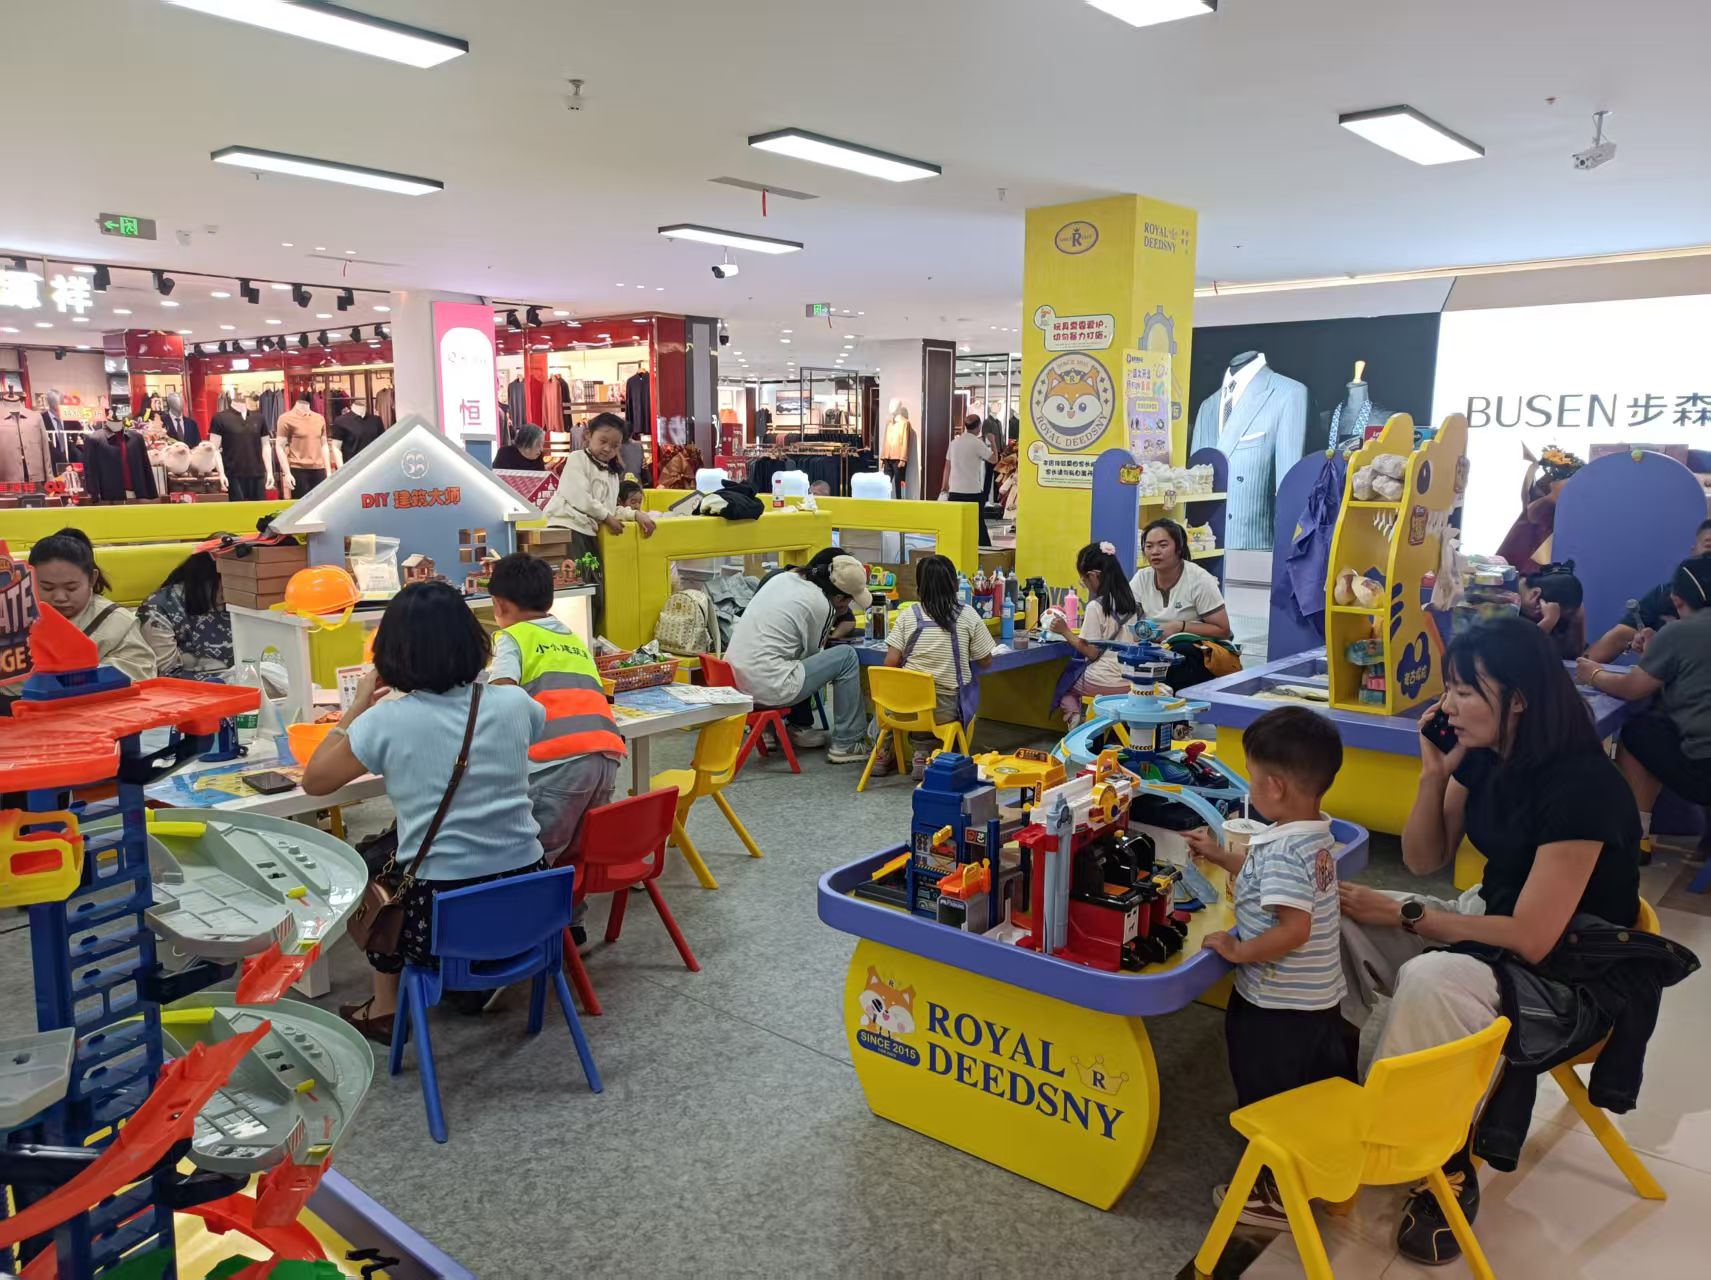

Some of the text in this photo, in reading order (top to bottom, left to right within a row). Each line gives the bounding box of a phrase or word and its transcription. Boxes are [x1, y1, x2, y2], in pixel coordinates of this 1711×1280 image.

[1144, 222, 1169, 238] ROYAL
[1144, 236, 1177, 254] DEEDSNY
[1467, 392, 1711, 428] BUSEN 步森
[1037, 413, 1108, 447] ROYAL DEEDSNY
[361, 486, 461, 509] DIY 建筑大师
[889, 979, 895, 988] R
[860, 1031, 891, 1050] SINCE
[892, 1041, 917, 1059] 2015
[926, 1001, 1066, 1078] ROYAL
[927, 1041, 1125, 1142] DEEDSNY
[1092, 1070, 1106, 1090] R
